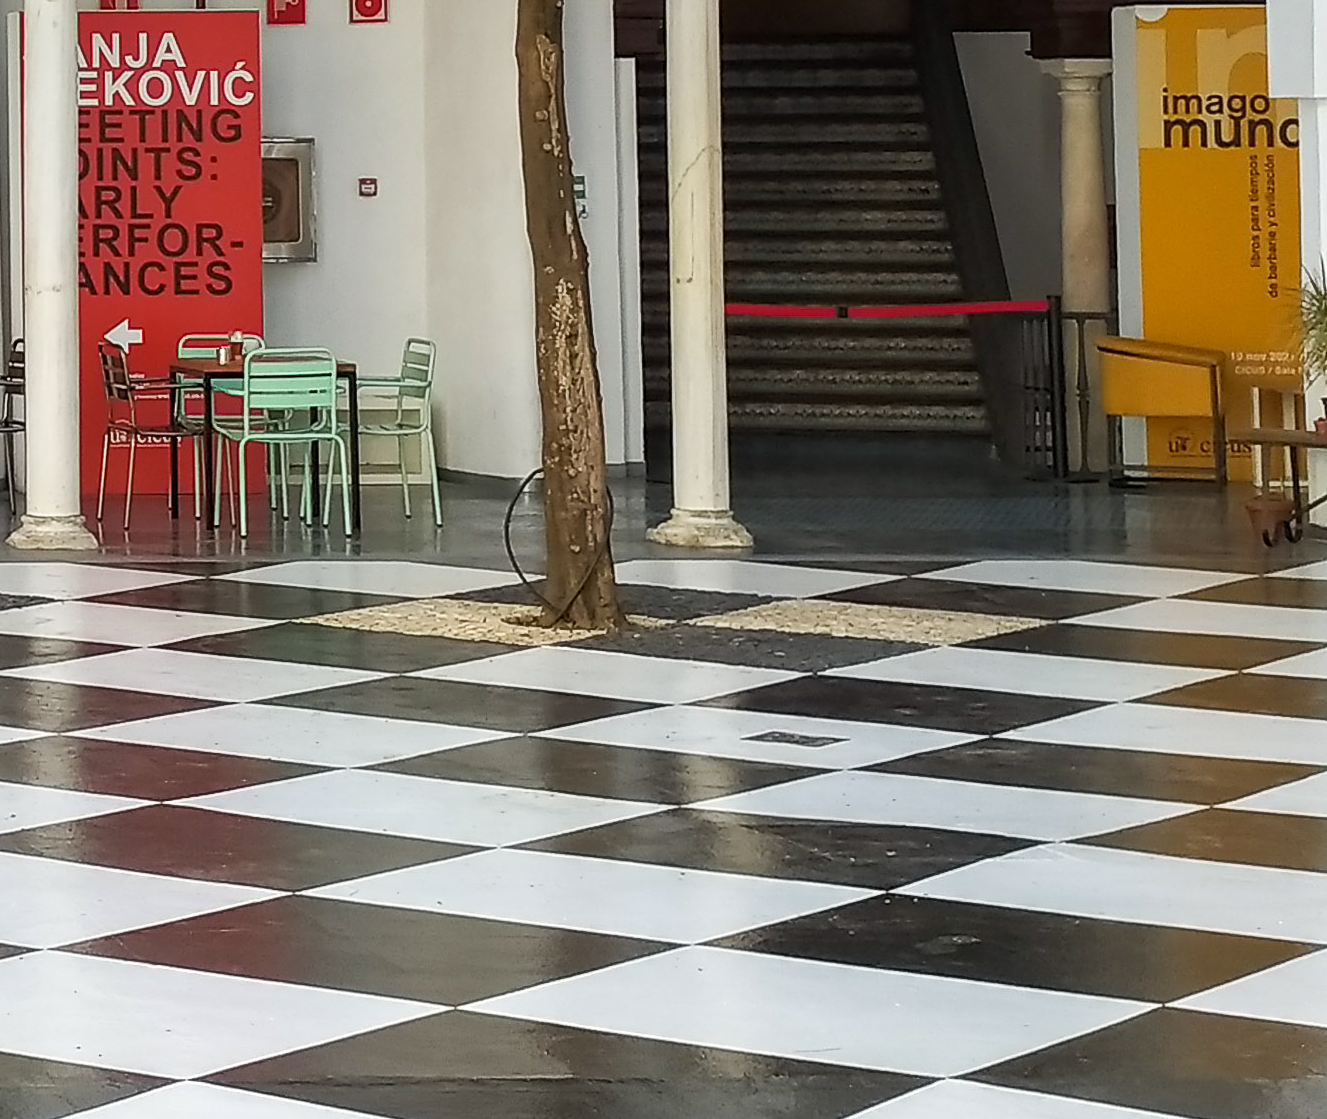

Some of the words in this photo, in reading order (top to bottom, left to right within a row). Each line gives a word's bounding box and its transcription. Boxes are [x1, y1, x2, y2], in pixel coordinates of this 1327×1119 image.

[1162, 87, 1270, 120] imago
[1248, 154, 1261, 202] tiempos
[1264, 154, 1277, 219] civilización
[1250, 205, 1262, 232] para
[78, 222, 244, 258] RFOR-
[1250, 233, 1261, 268] libros
[1266, 230, 1278, 280] barbarie
[1267, 283, 1278, 298] de
